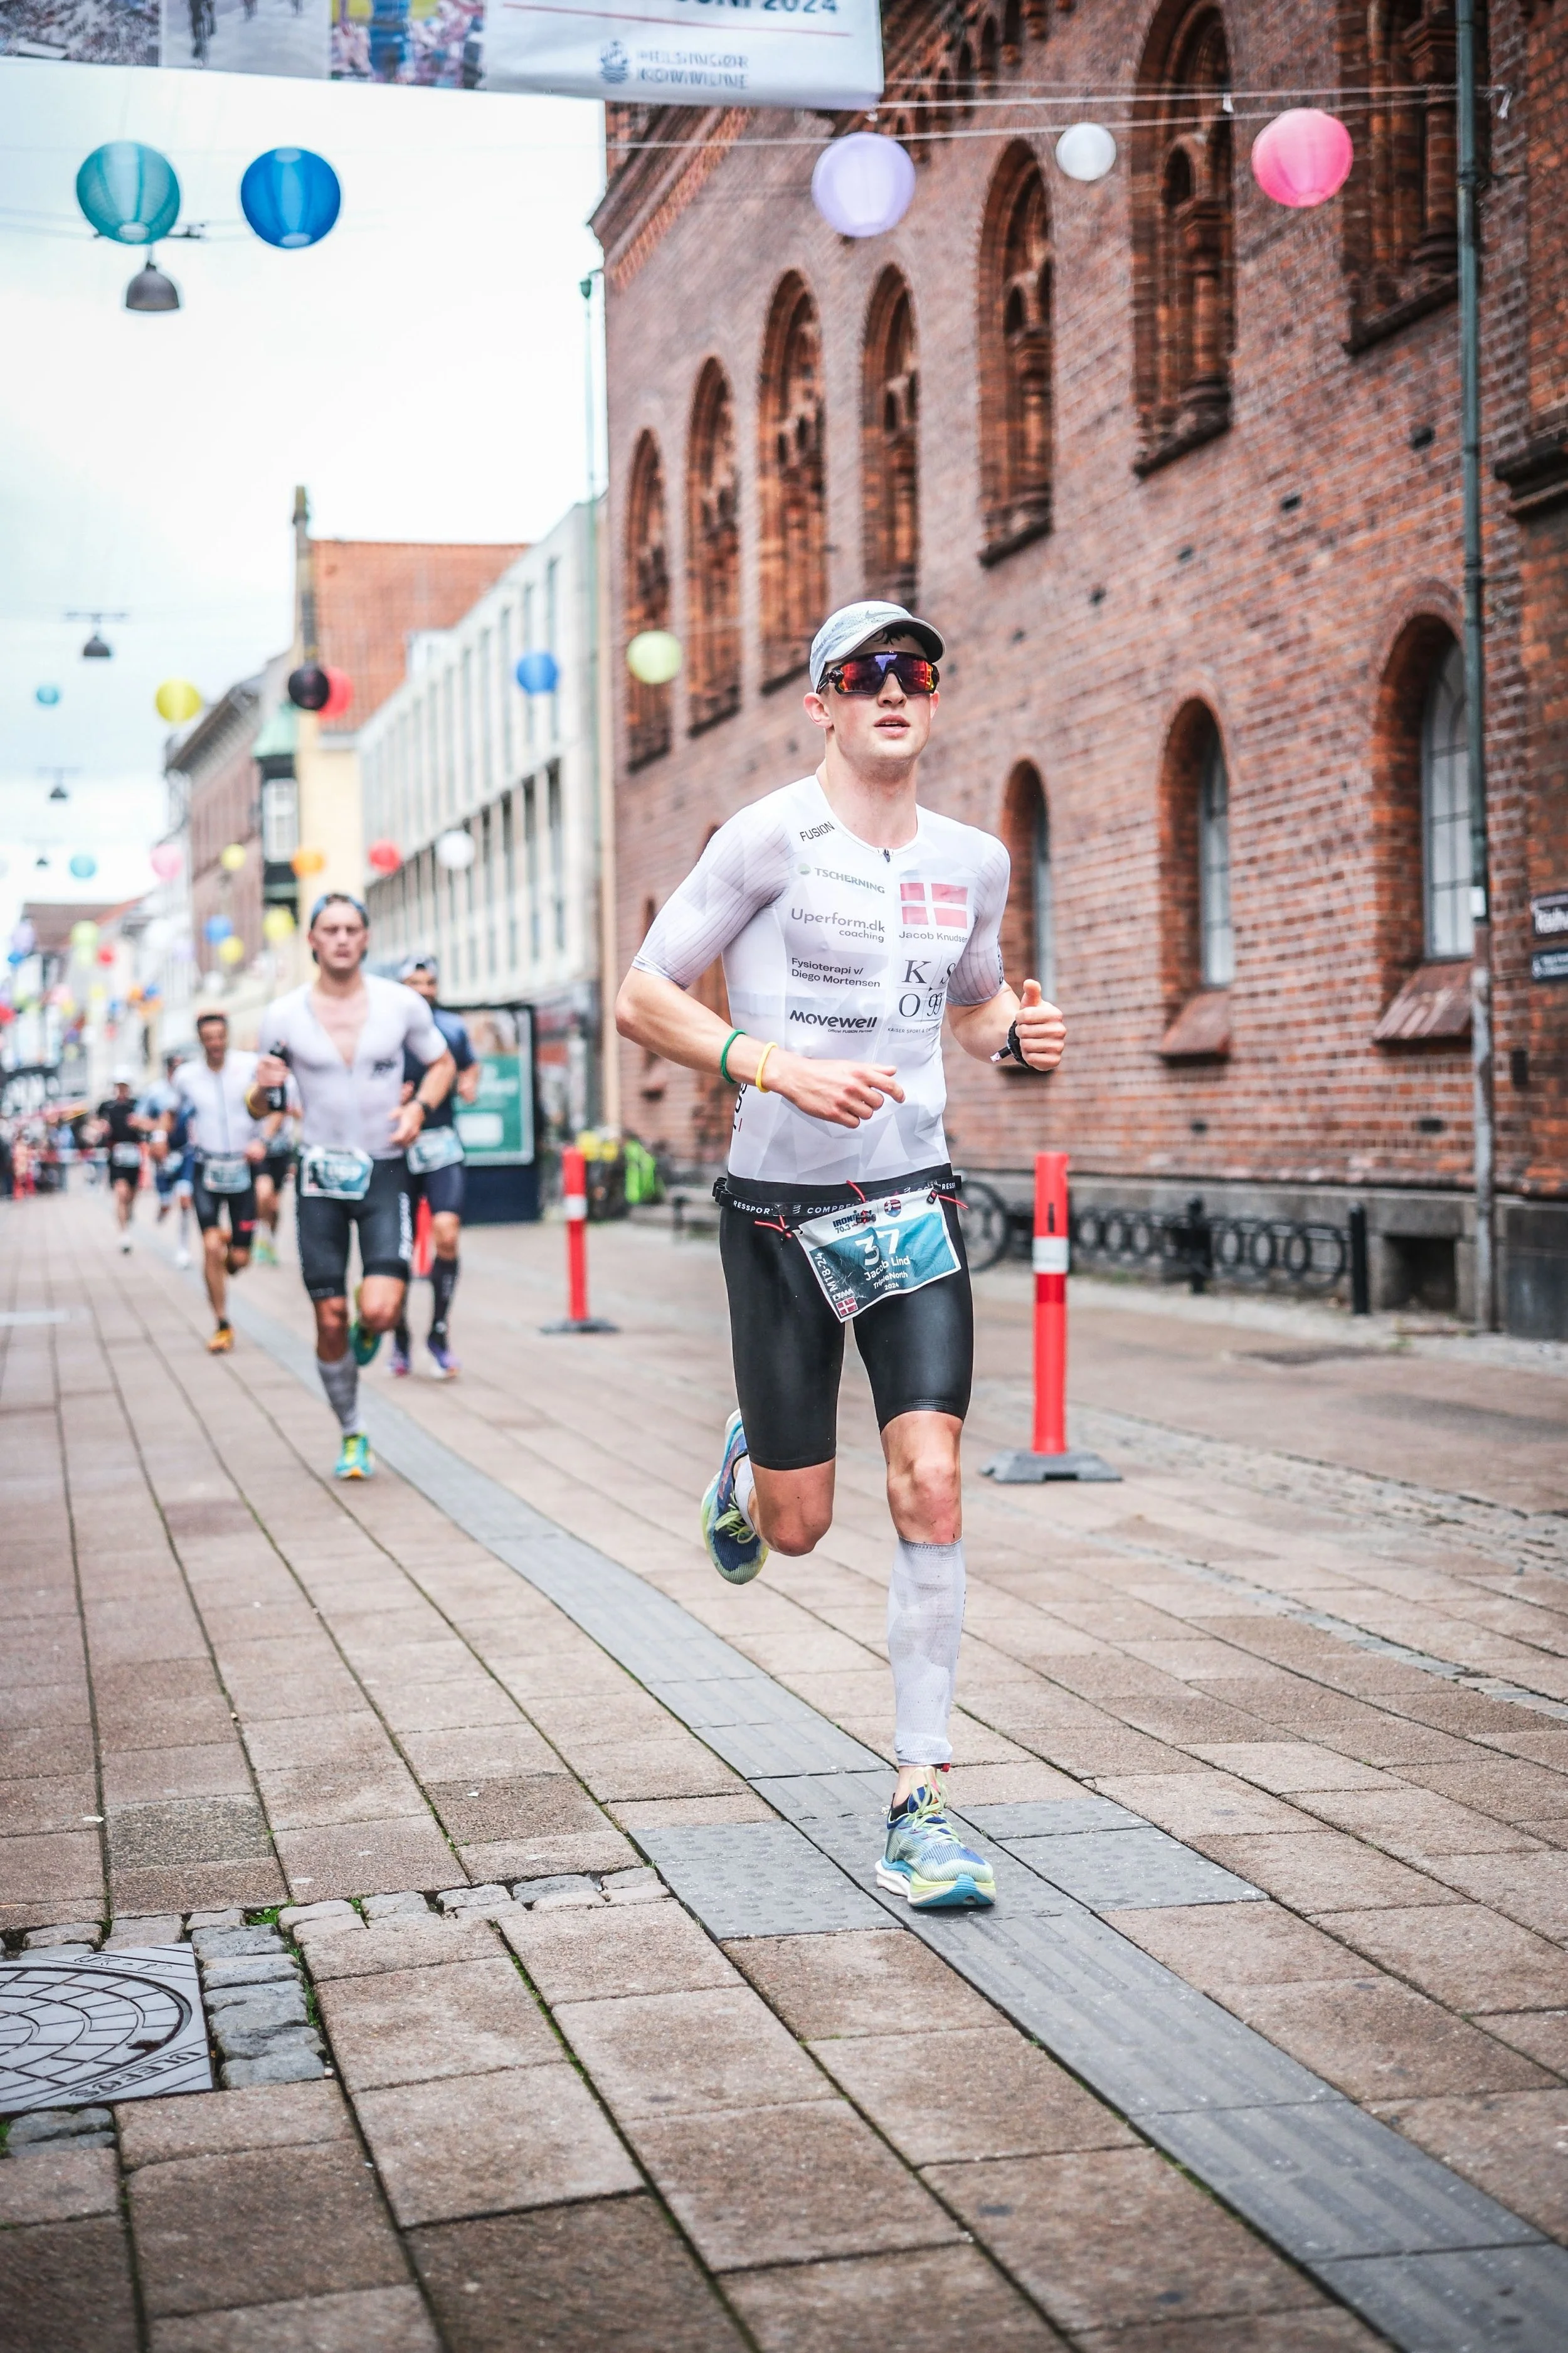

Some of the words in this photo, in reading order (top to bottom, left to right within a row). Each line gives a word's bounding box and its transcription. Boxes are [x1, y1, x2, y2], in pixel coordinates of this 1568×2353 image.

[800, 821, 835, 841] FUSION
[814, 867, 885, 894] TSCHERNING
[791, 908, 885, 932] Uperform.dk
[839, 930, 884, 943] coaching
[899, 931, 934, 940] Jacob
[792, 957, 851, 975] Fysioterapi
[792, 969, 820, 982] Diego
[823, 975, 880, 987] Mortensen
[733, 1200, 774, 1214] RESSPOR
[835, 1223, 851, 1234] 70.3
[855, 1228, 900, 1266] 37
[815, 1252, 839, 1292] M18-24
[864, 1260, 889, 1281] Jacob
[891, 1255, 911, 1267] Lind
[873, 1271, 909, 1289] TripleNorth
[884, 1282, 899, 1290] 2024
[69, 2051, 201, 2098] ULEFOS
